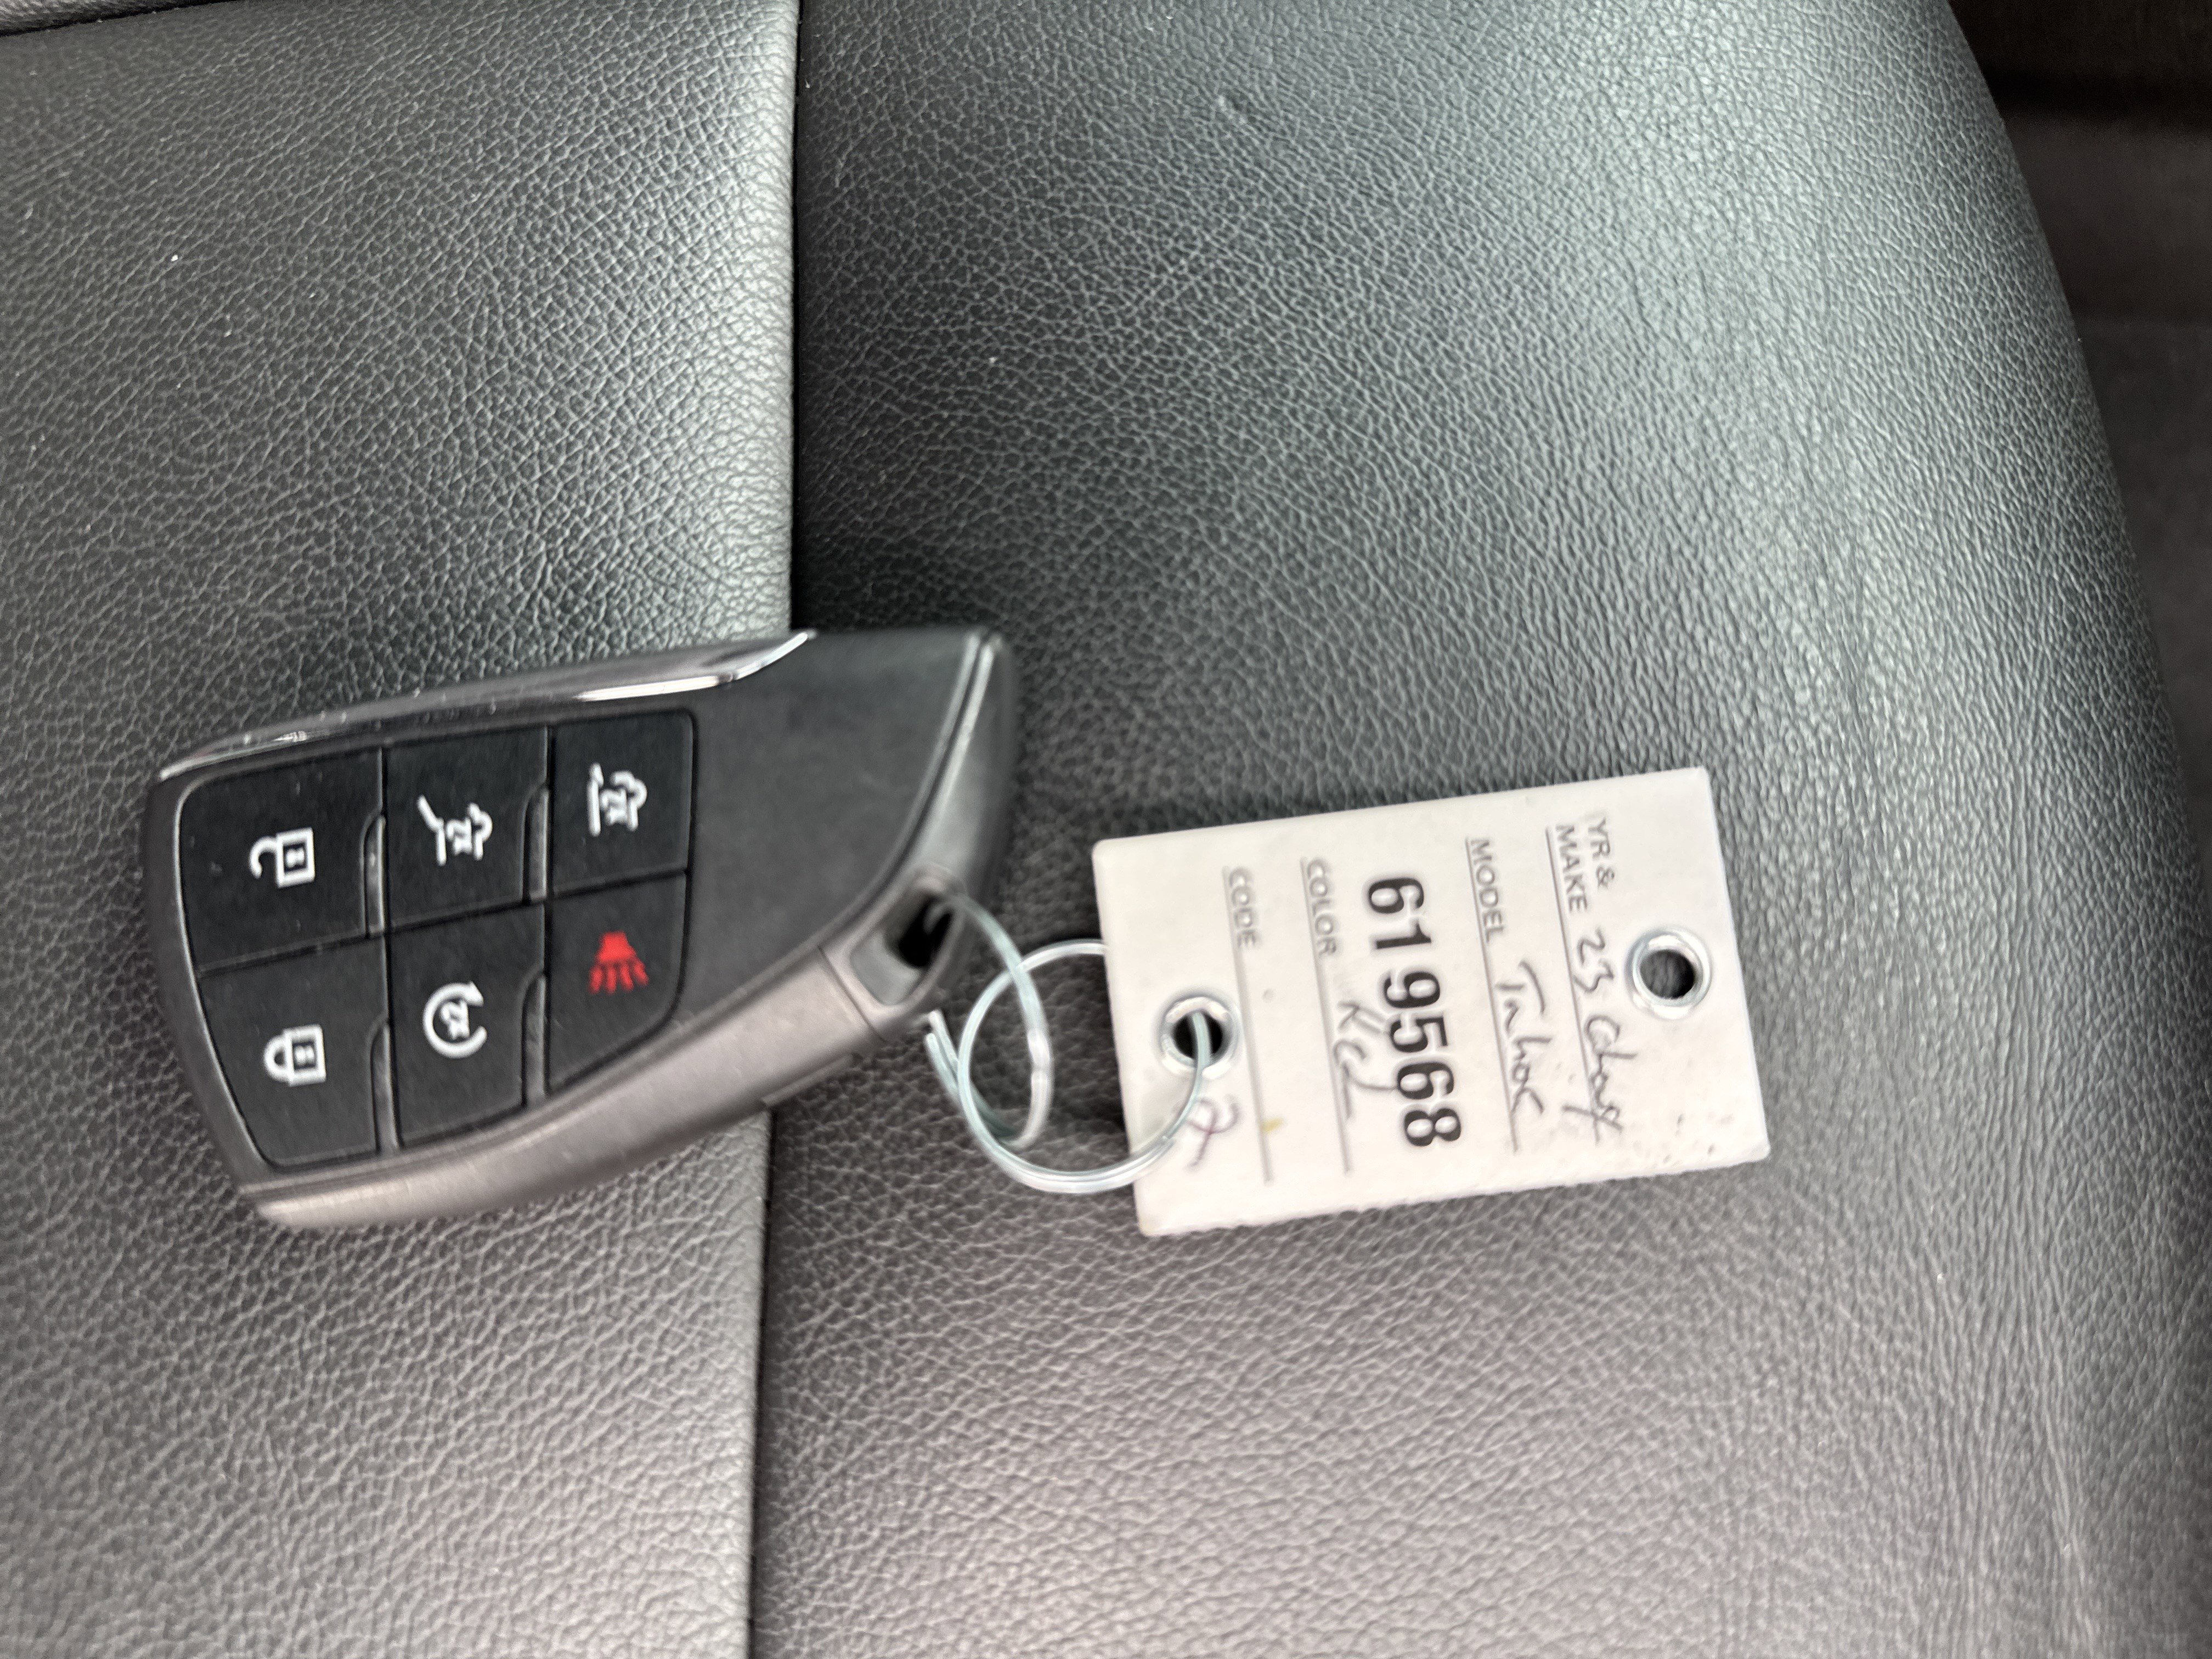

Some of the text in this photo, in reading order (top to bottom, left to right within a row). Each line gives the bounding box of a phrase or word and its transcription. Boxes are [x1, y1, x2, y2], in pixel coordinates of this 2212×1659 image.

[1470, 838, 1504, 943] MODEL
[1556, 824, 1588, 913] MAKE
[1587, 819, 1615, 890] YR &
[1228, 868, 1259, 948] CODE
[1307, 858, 1338, 956] COLOR
[1574, 929, 1614, 994] 23
[1367, 877, 1462, 1147] 619568
